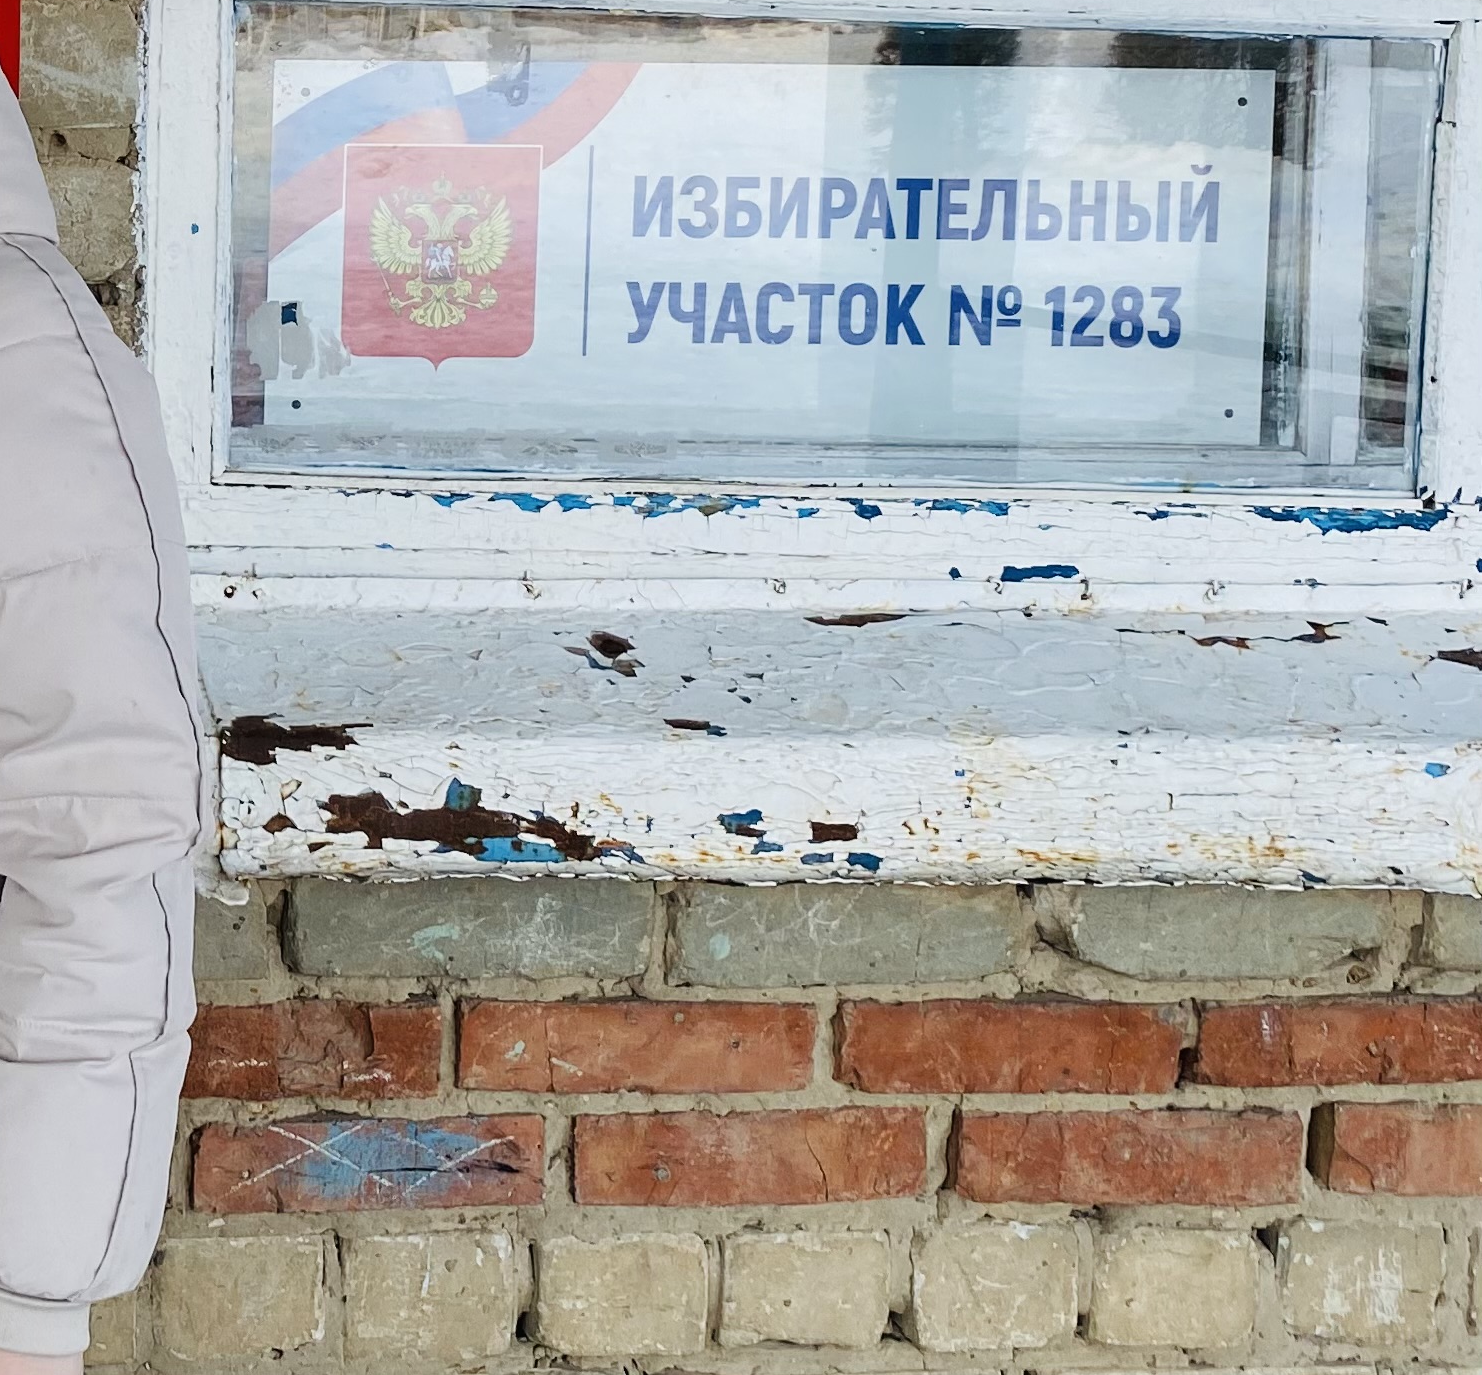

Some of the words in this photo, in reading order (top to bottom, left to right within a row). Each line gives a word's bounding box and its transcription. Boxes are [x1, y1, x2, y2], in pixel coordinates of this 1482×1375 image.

[630, 163, 1220, 244] ИЗБИРАТЕЛЬНЫЙ
[625, 282, 925, 346] УЧАСТОК
[947, 285, 1022, 347] №
[1046, 285, 1182, 350] 1283
